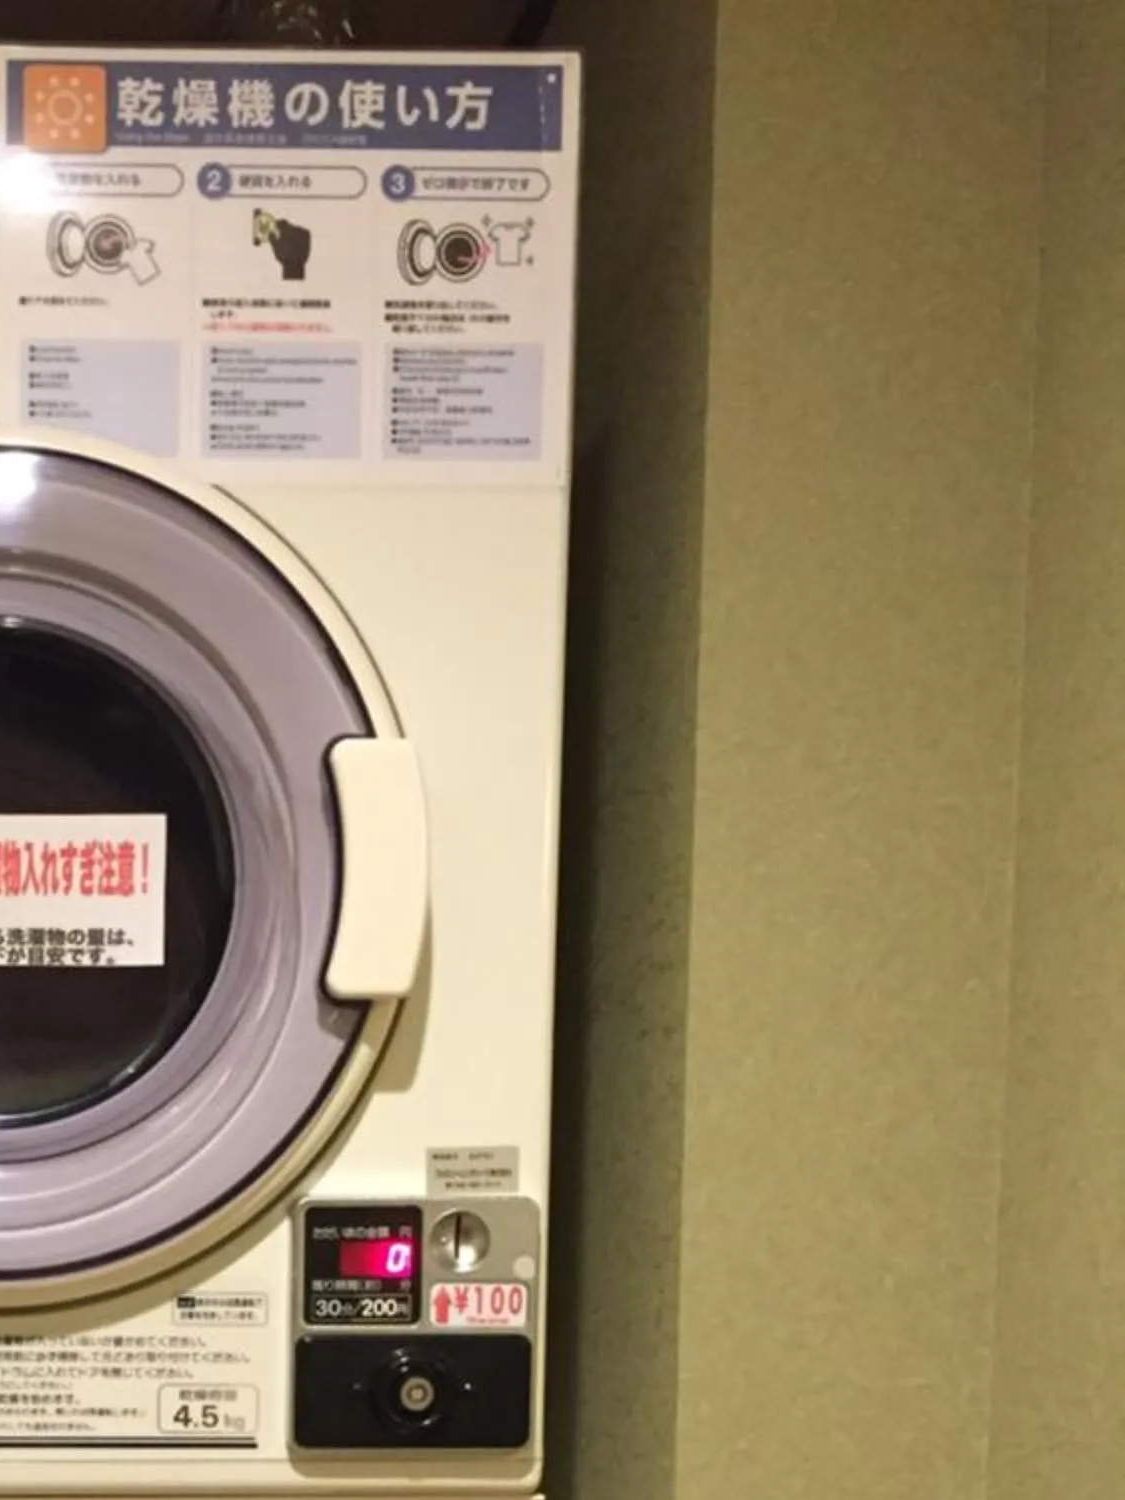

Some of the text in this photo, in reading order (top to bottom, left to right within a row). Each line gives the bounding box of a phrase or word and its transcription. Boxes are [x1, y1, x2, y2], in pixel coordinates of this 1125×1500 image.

[116, 77, 495, 132] 乾燥機の使い方
[206, 170, 222, 192] 2
[390, 173, 406, 193] 3
[385, 1243, 411, 1273] 0
[173, 1404, 220, 1429] 4.5
